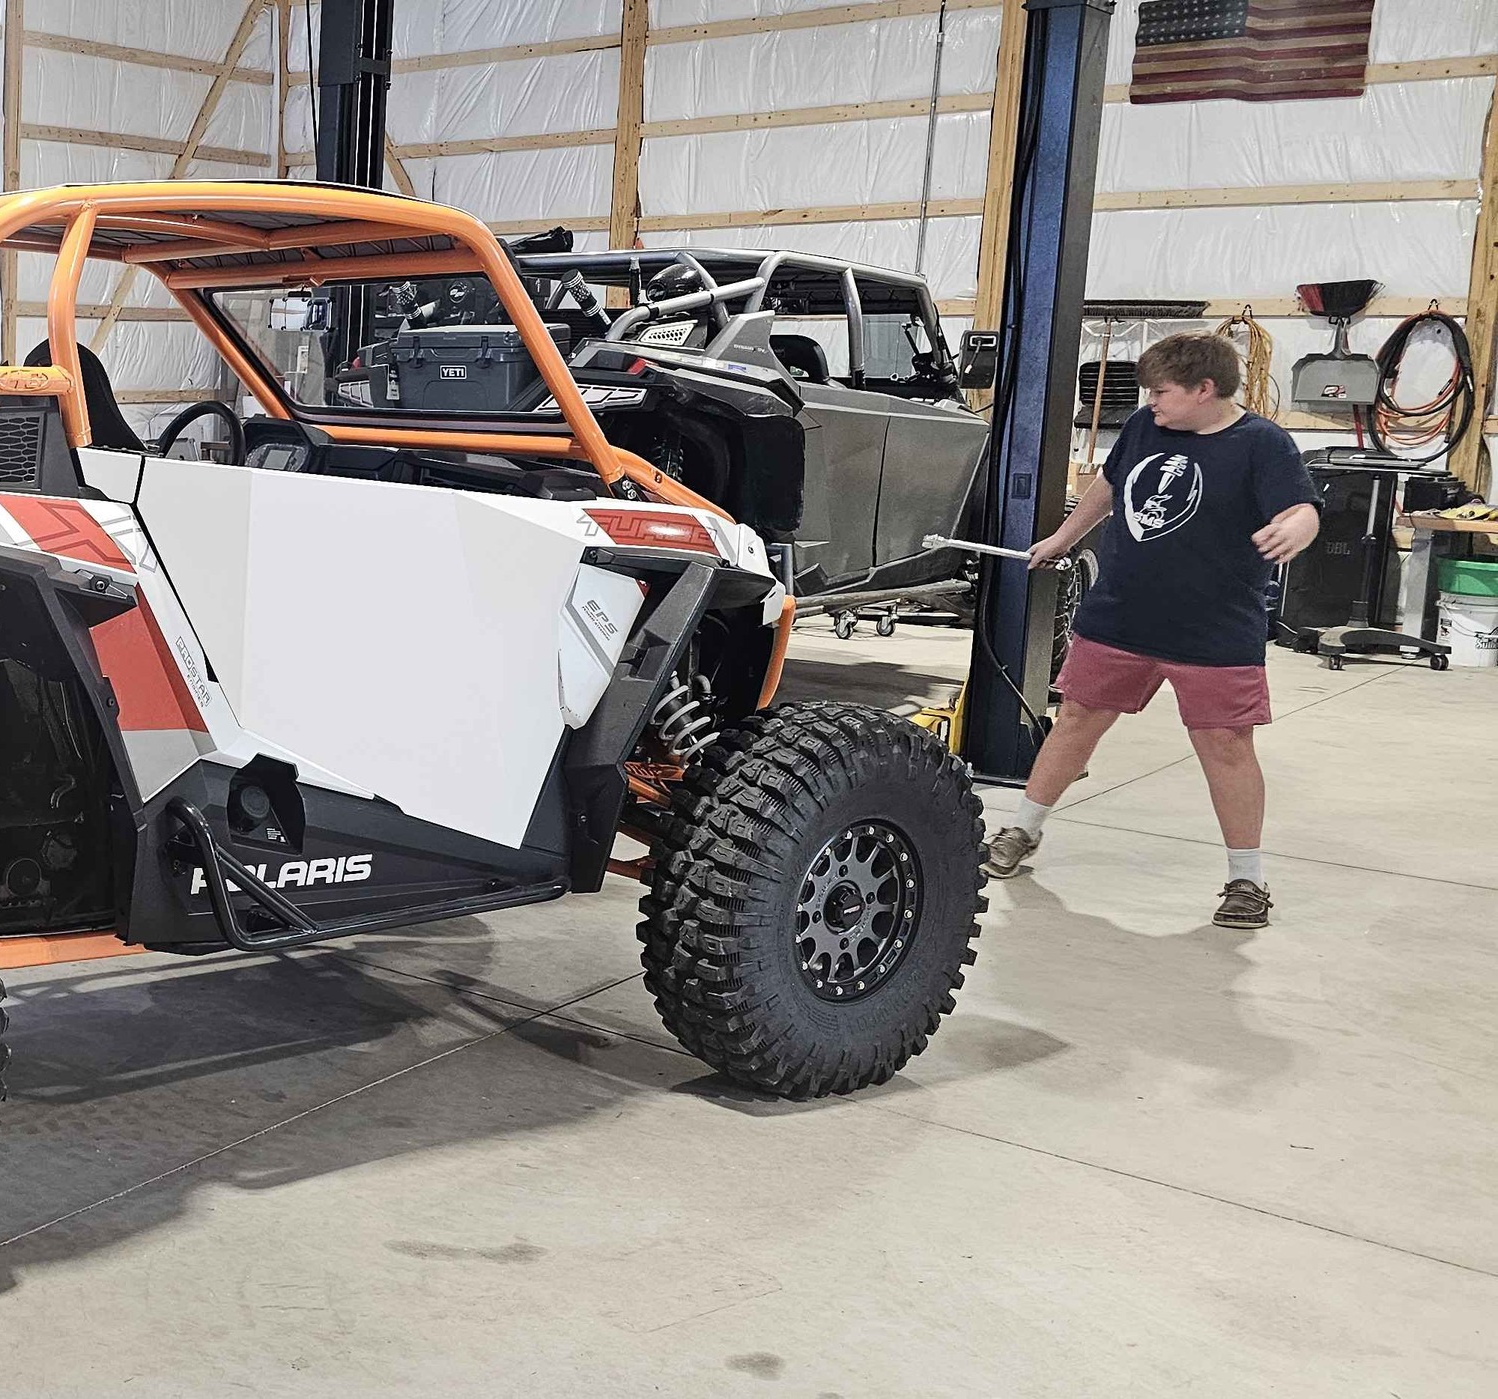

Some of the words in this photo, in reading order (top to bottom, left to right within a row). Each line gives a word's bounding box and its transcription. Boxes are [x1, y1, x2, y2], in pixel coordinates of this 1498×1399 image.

[442, 367, 465, 378] YETI
[1133, 511, 1165, 529] SMS
[586, 599, 618, 635] EPS
[175, 635, 213, 707] PROSTAR
